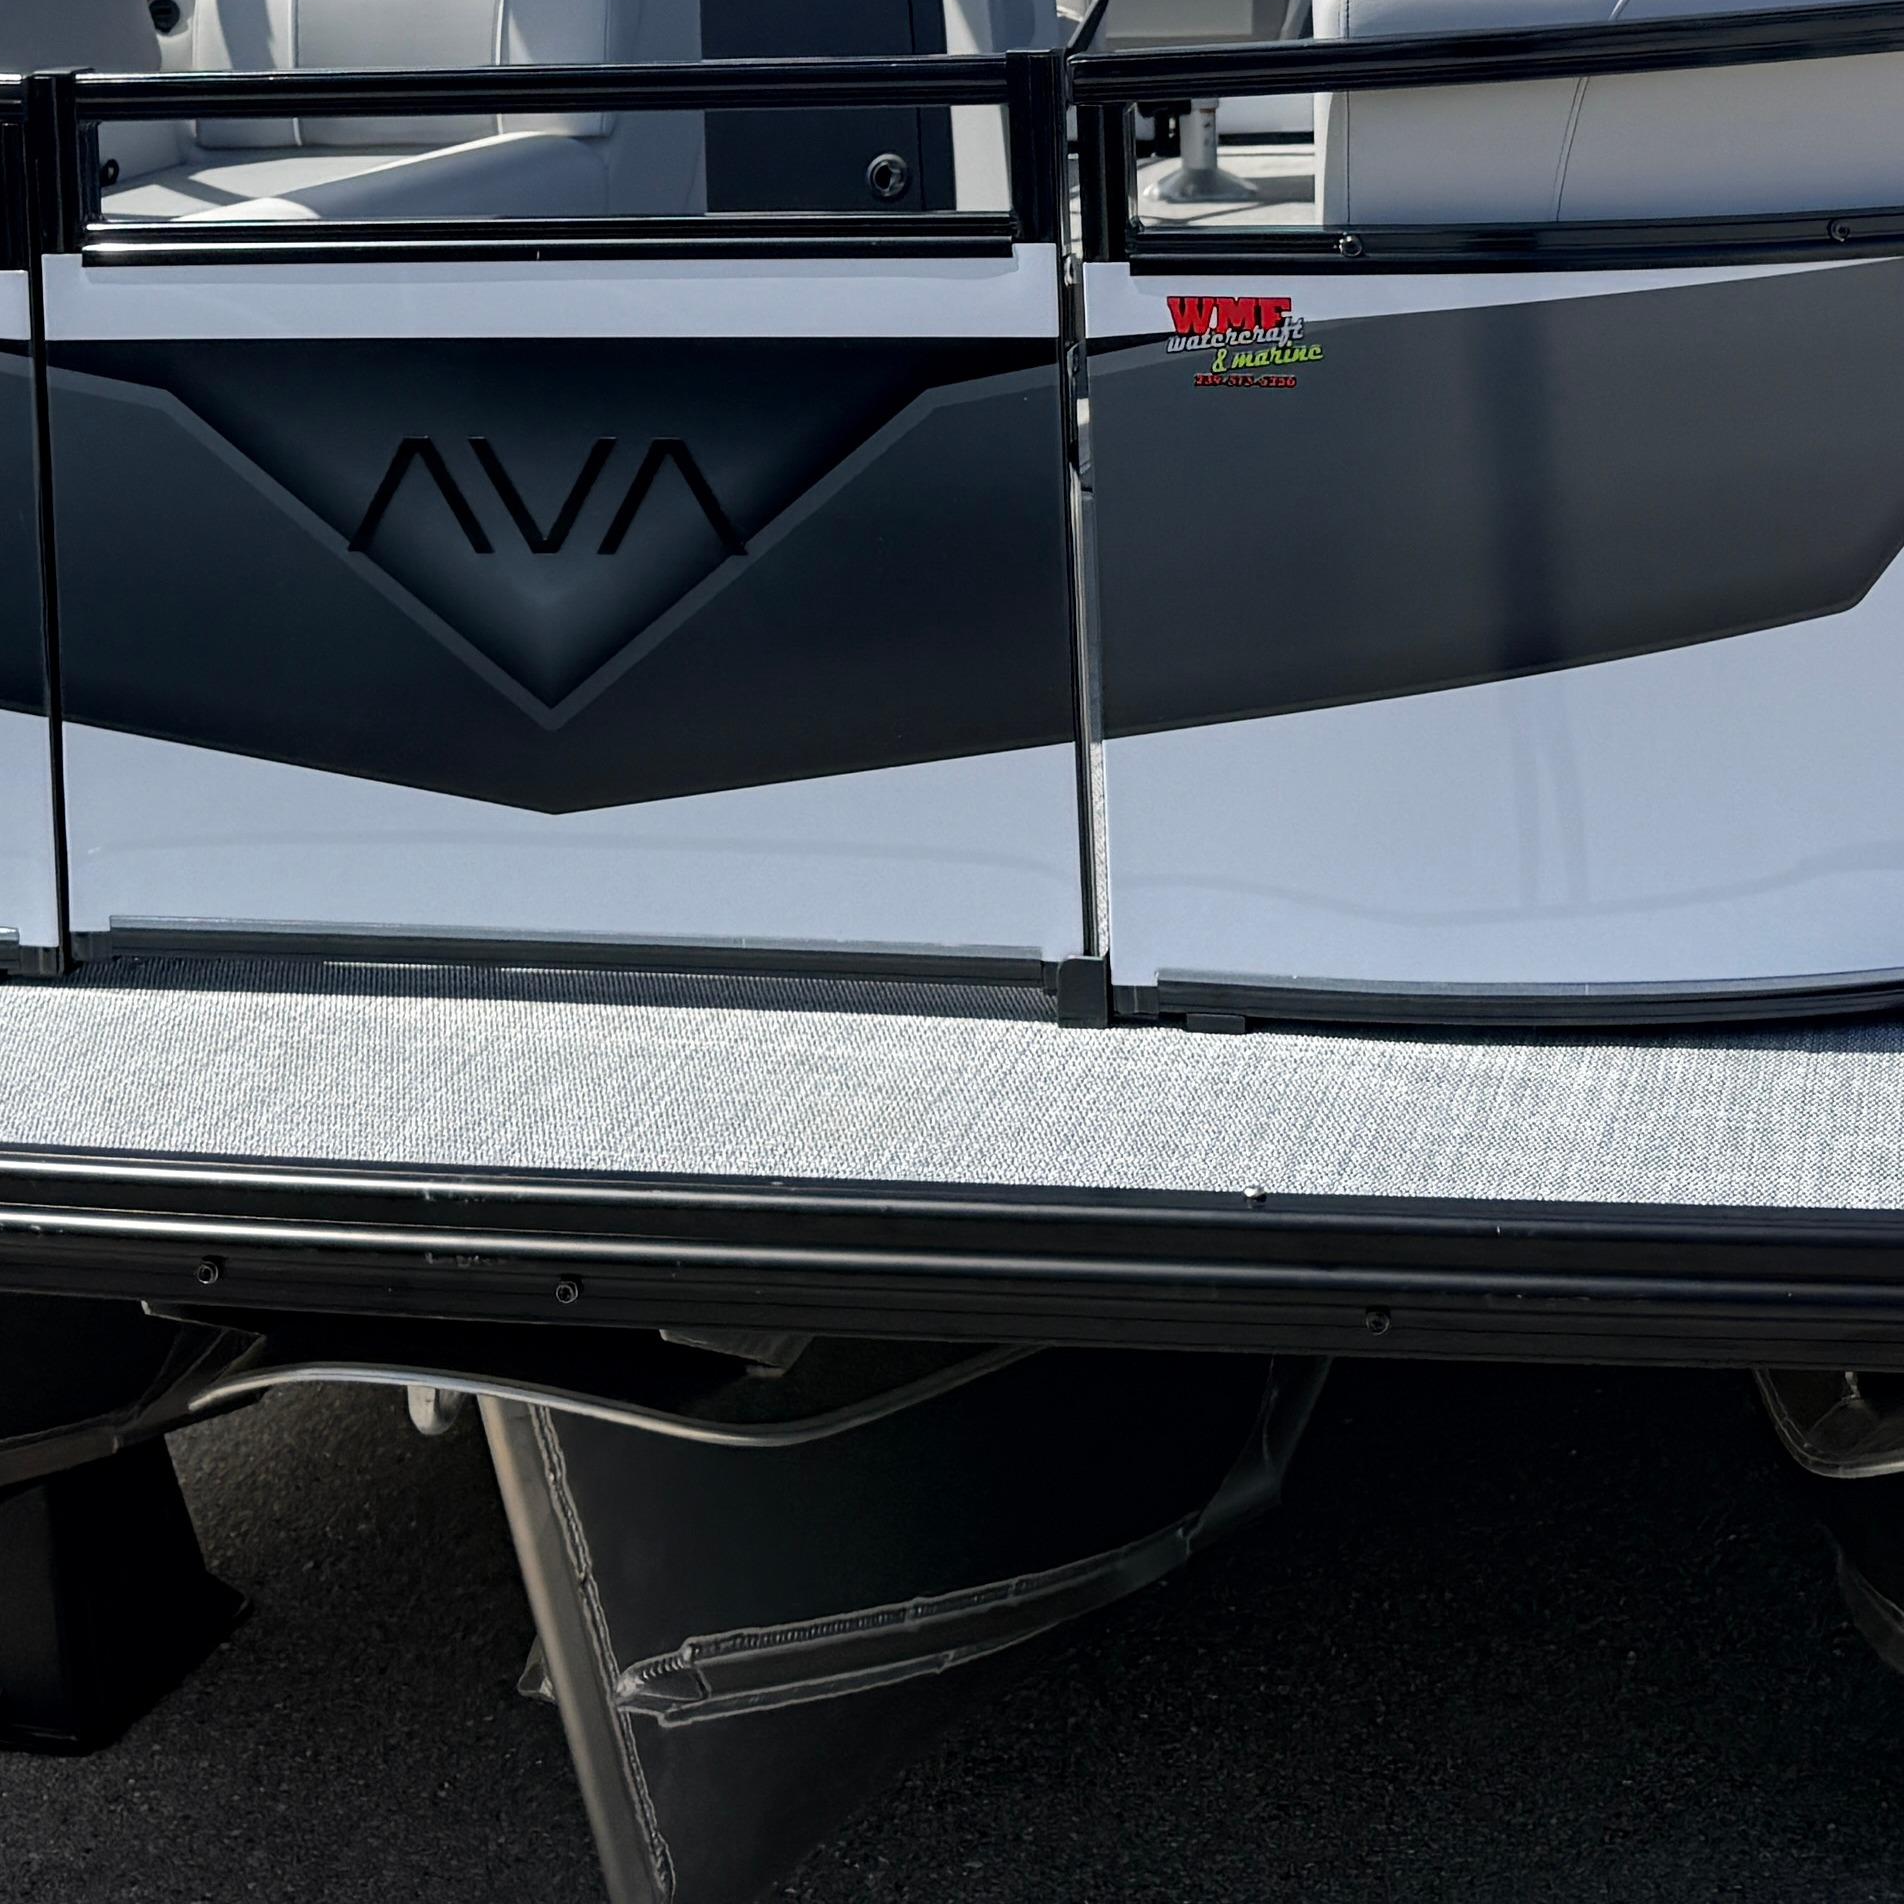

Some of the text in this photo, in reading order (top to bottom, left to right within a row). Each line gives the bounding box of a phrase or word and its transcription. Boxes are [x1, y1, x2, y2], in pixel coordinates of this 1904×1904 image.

[1166, 296, 1292, 334] WMF
[1167, 317, 1305, 353] watercraft
[1211, 340, 1324, 373] & marine
[347, 435, 749, 556] AVA
